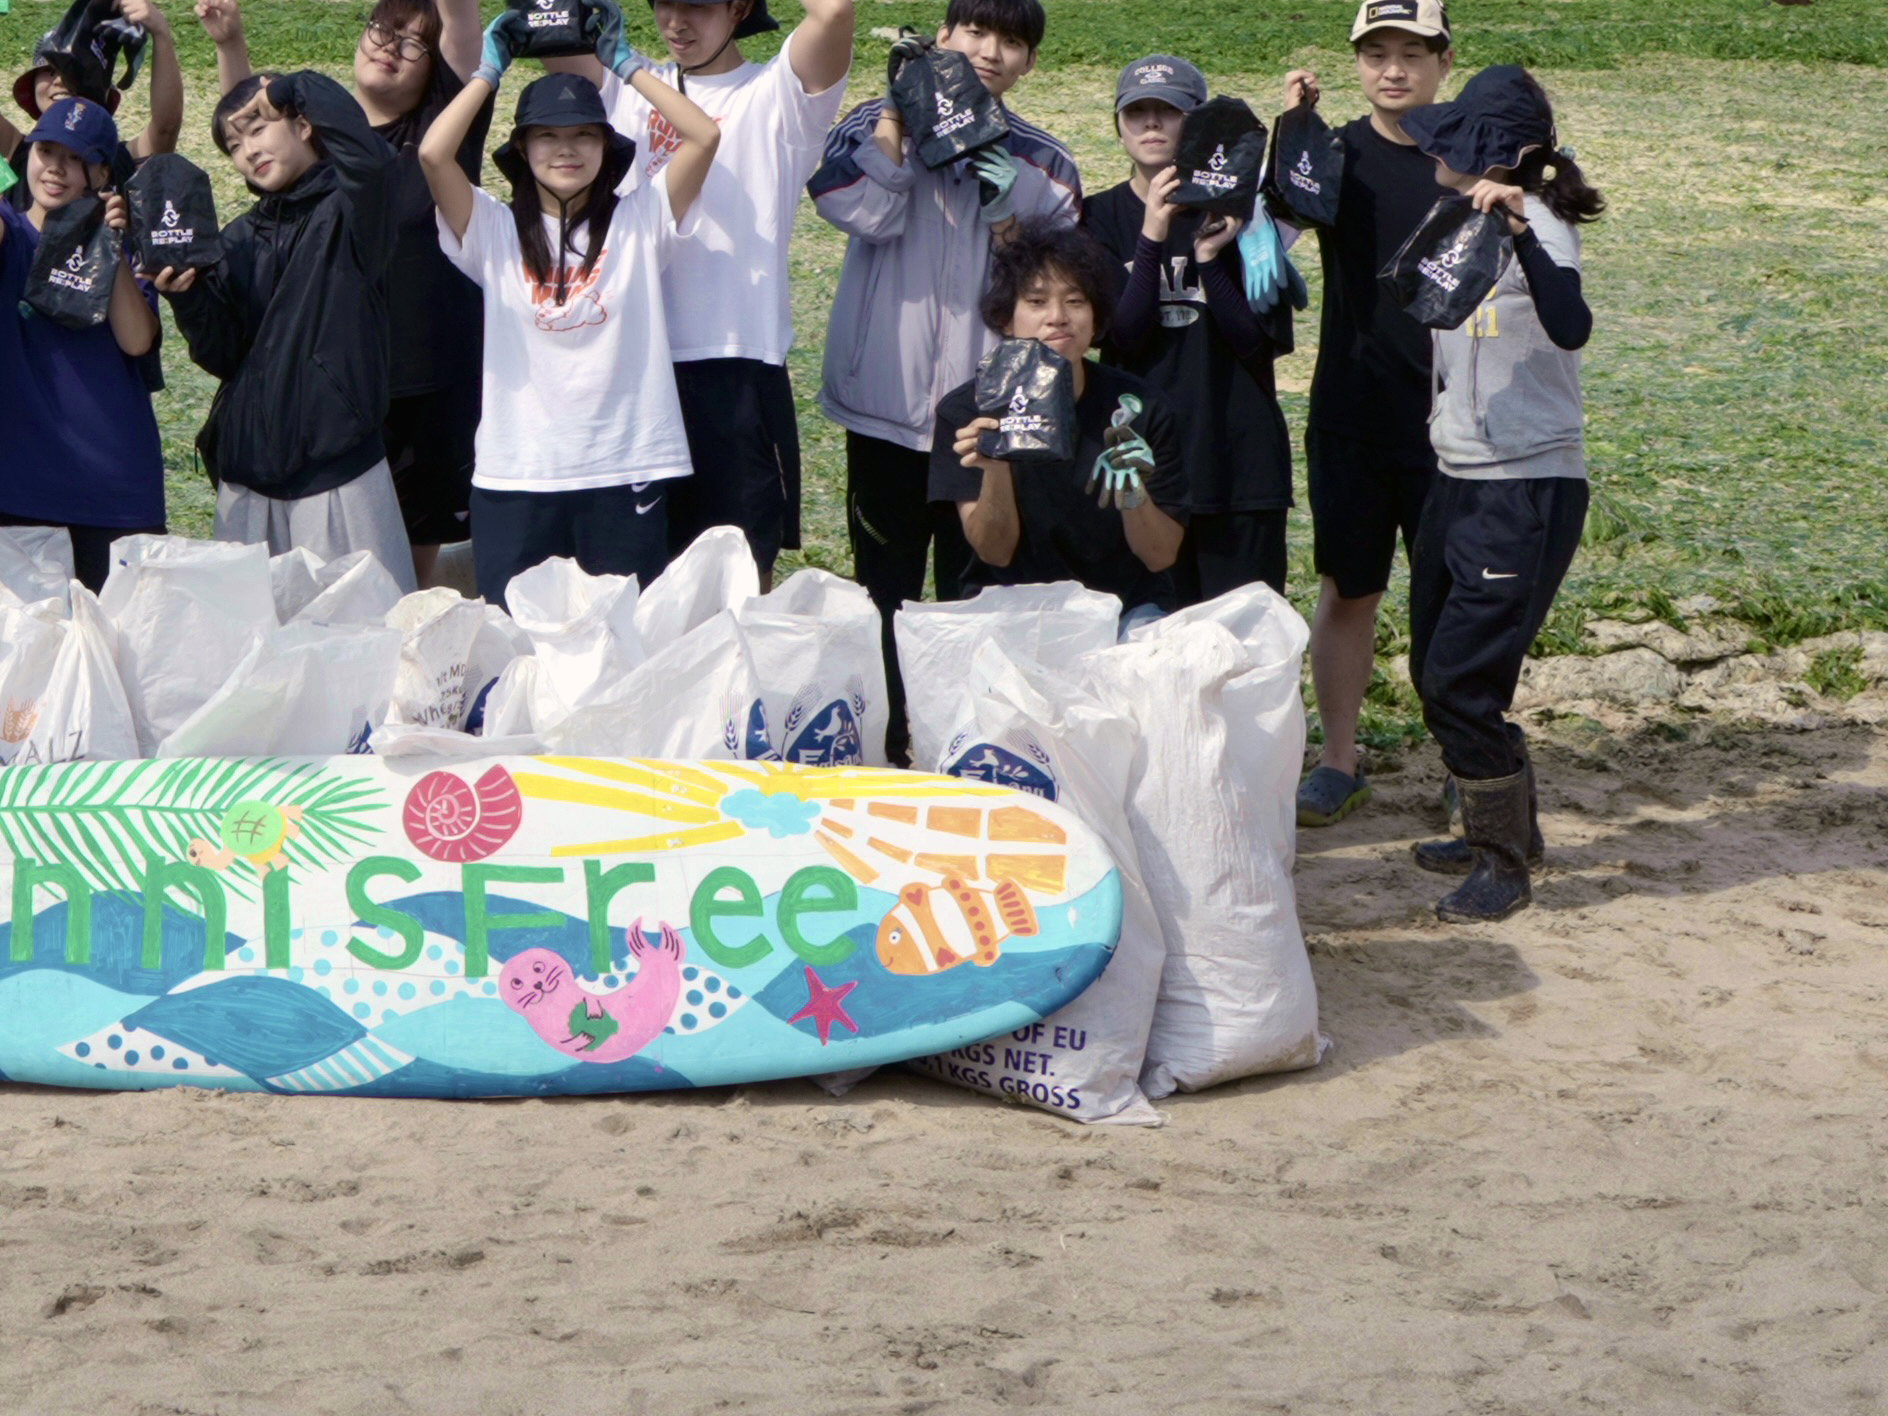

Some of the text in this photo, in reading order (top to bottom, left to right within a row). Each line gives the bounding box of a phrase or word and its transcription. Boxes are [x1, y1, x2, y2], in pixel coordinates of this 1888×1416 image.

[528, 11, 569, 21] BOTTLE
[932, 108, 973, 133] BOTTLE
[1193, 170, 1238, 184] BOTTLE
[151, 229, 193, 238] BOTTLE
[50, 268, 92, 285] BOTTLE
[1421, 257, 1460, 288] BOTTLE
[1000, 415, 1042, 425] BOTTLE
[1012, 1023, 1086, 1051] OF EU
[1004, 1048, 1055, 1076] NET.
[947, 1062, 992, 1089] KGS
[999, 1077, 1080, 1109] GROSS
